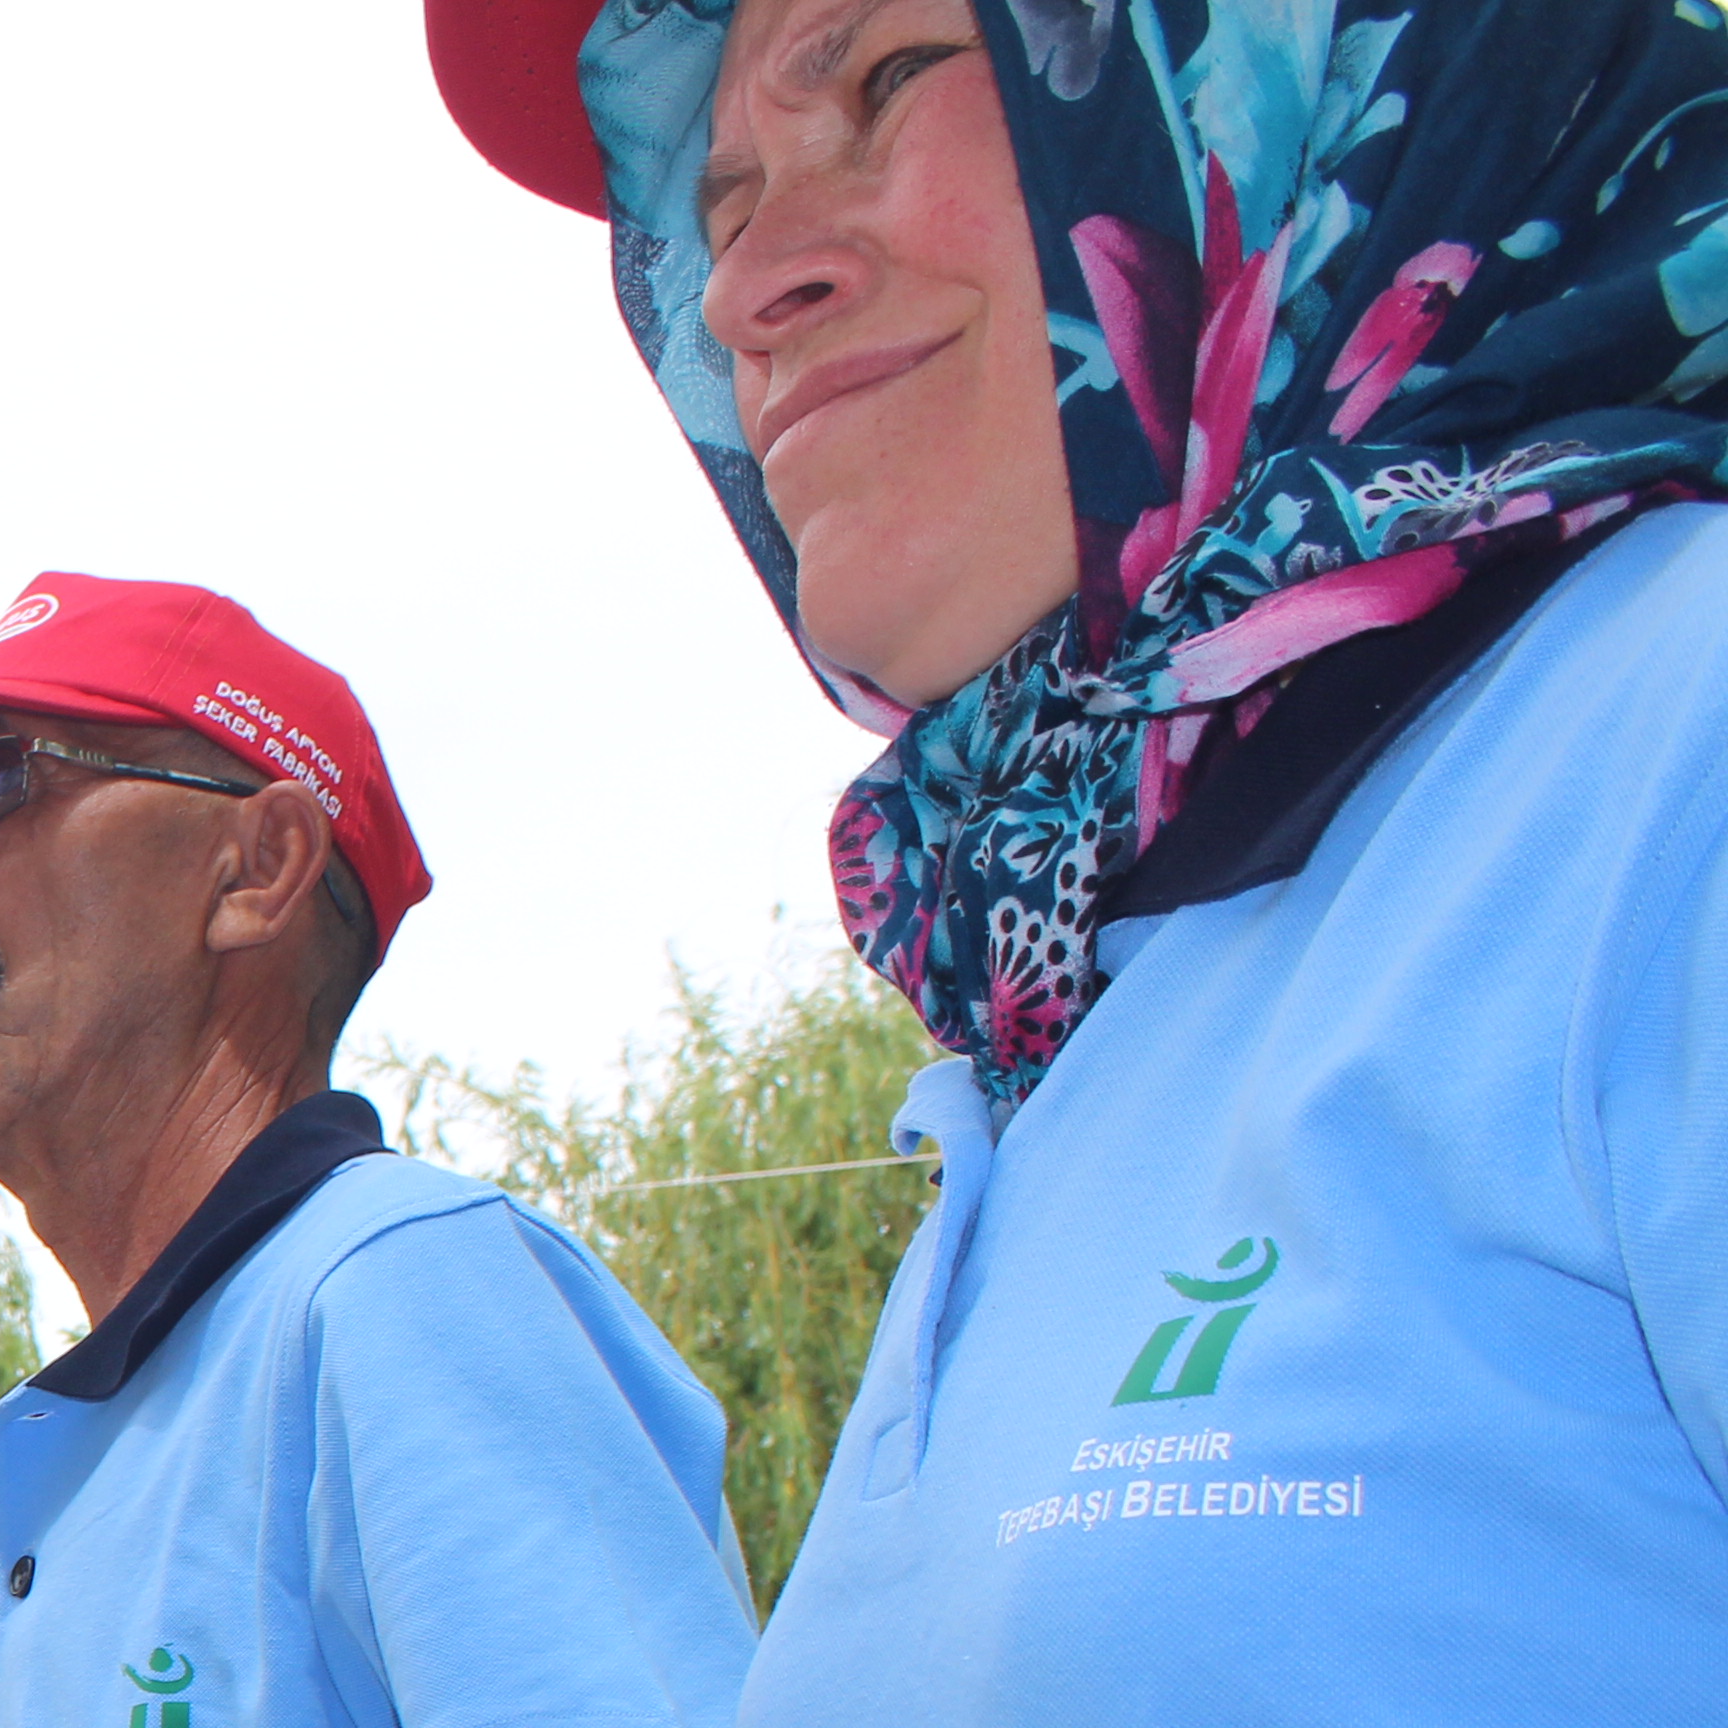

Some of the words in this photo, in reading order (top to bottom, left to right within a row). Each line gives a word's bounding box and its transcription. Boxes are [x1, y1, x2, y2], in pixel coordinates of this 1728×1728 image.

[192, 694, 259, 744] ŞEKER
[262, 736, 343, 820] FABRİKASI
[215, 680, 284, 733] DOĞUŞ
[285, 726, 343, 785] AFYON
[1070, 1427, 1233, 1473] ESKİŞEHİR
[995, 1488, 1114, 1549] TEPEBAŞI
[1120, 1474, 1364, 1519] BELEDİYESİ
